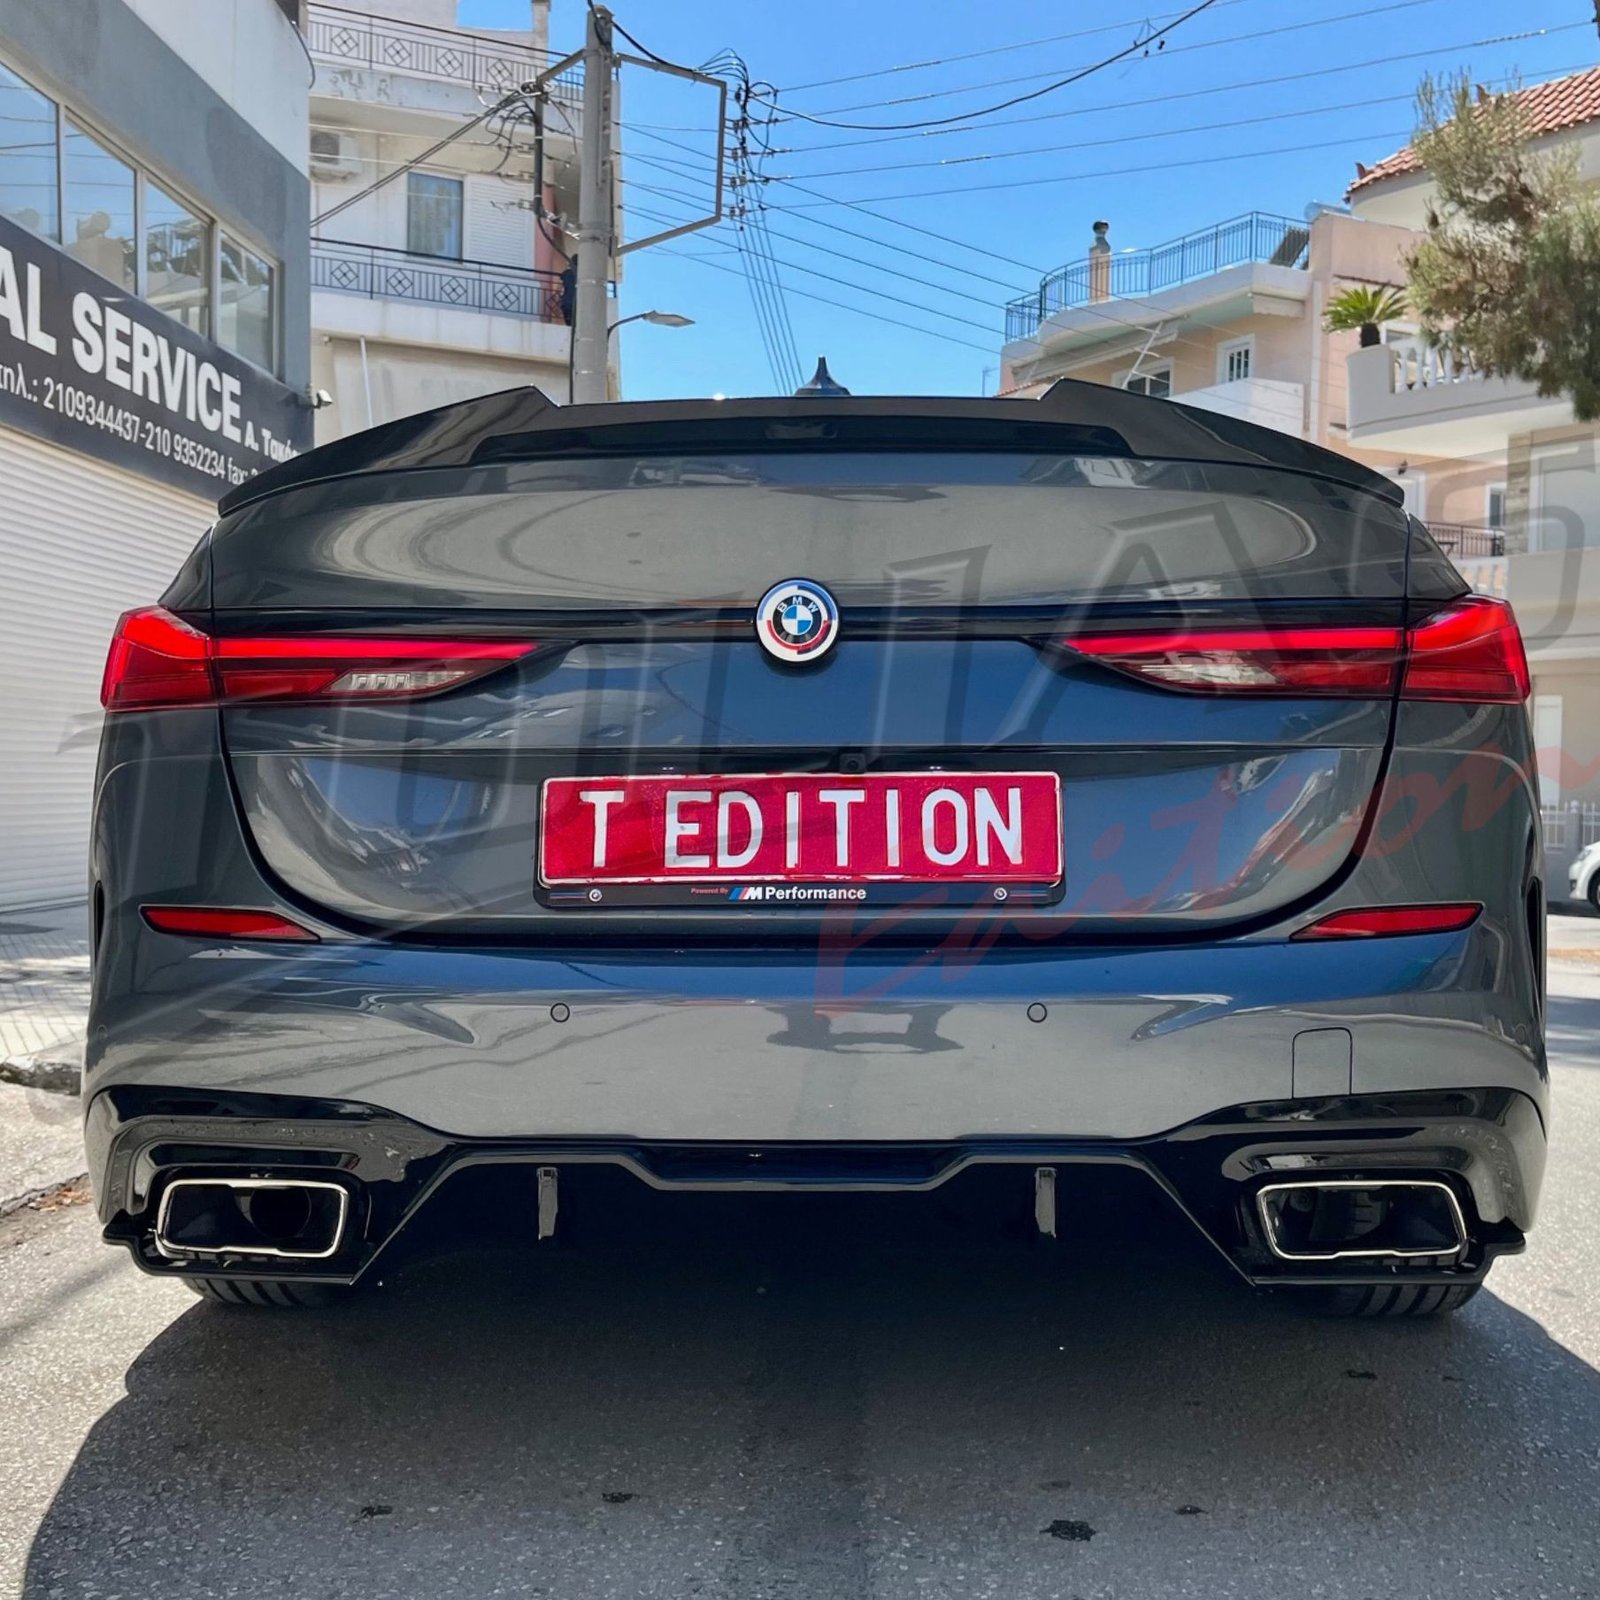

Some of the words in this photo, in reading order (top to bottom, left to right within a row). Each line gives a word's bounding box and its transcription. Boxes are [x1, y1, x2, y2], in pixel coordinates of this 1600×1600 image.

[72, 291, 242, 443] SERVICE
[43, 377, 171, 457] 2109344437-210
[173, 433, 226, 479] 9352234
[776, 596, 819, 613] BMW
[579, 789, 625, 868] T
[664, 787, 1022, 869] EDITION
[765, 886, 867, 900] Performance
